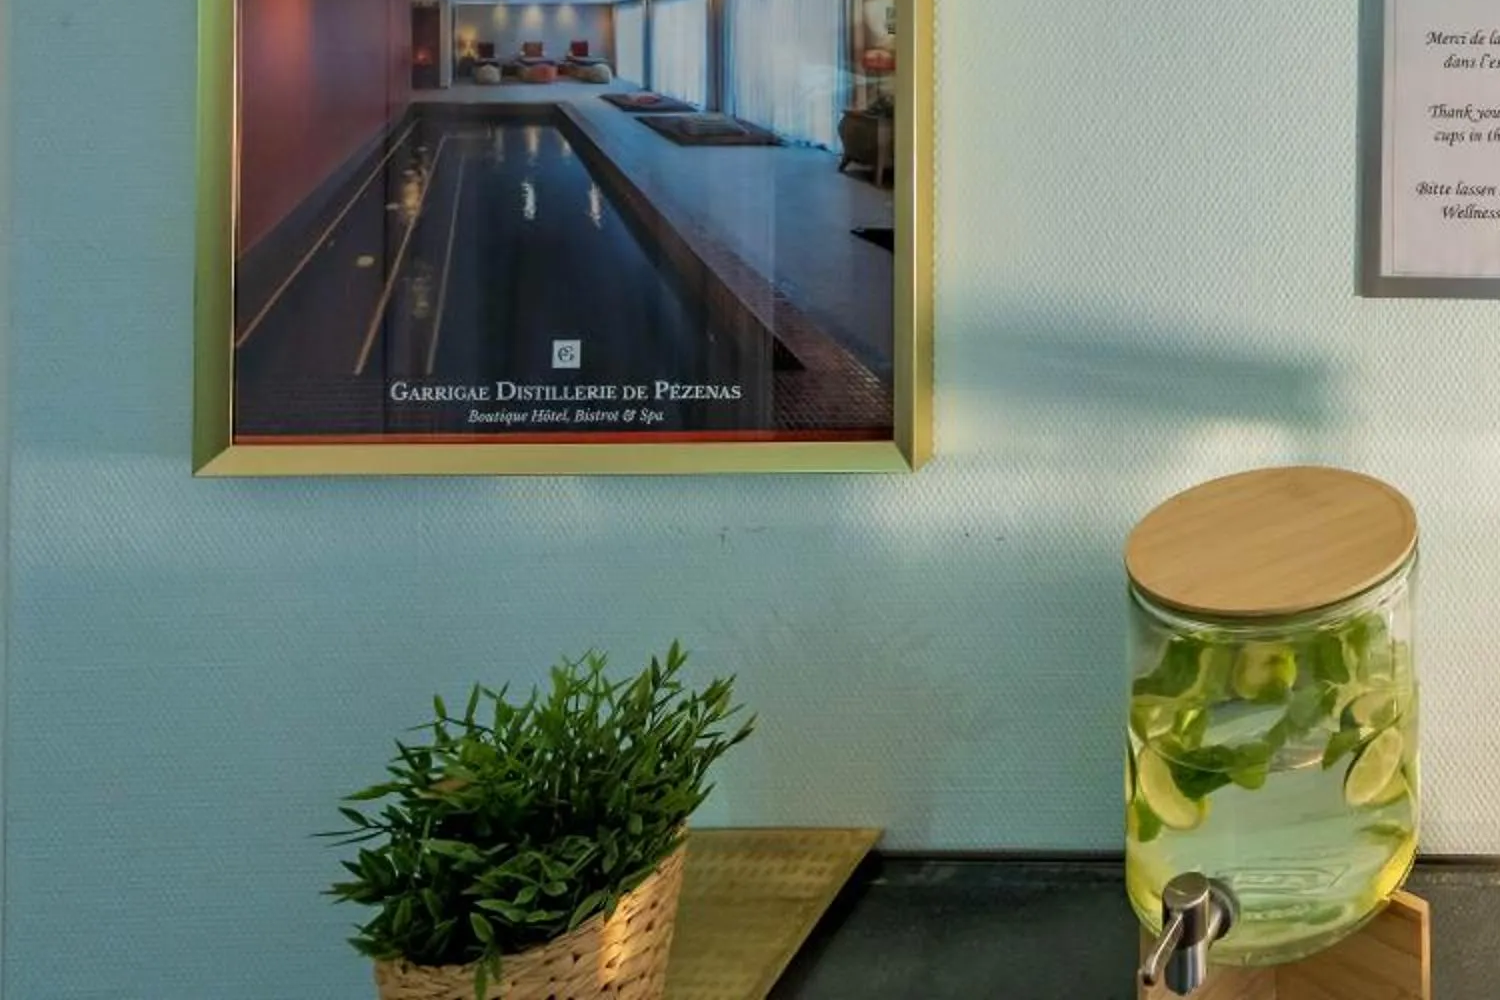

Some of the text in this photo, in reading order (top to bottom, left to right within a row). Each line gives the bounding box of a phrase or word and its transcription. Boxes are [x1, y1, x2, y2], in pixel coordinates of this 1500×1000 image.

[1425, 31, 1467, 46] Merci
[1469, 30, 1484, 46] de
[1443, 54, 1476, 69] dans
[1428, 104, 1477, 122] Thank
[1434, 131, 1465, 146] cups
[1469, 130, 1482, 142] in
[1416, 181, 1451, 196] Bitte
[1455, 181, 1496, 196] lassen
[391, 381, 488, 401] GARRIGAE
[496, 381, 619, 401] DISTILLERIE
[623, 386, 648, 400] DE
[468, 408, 664, 424] Boutique Hôtel, Bistrot & Spa
